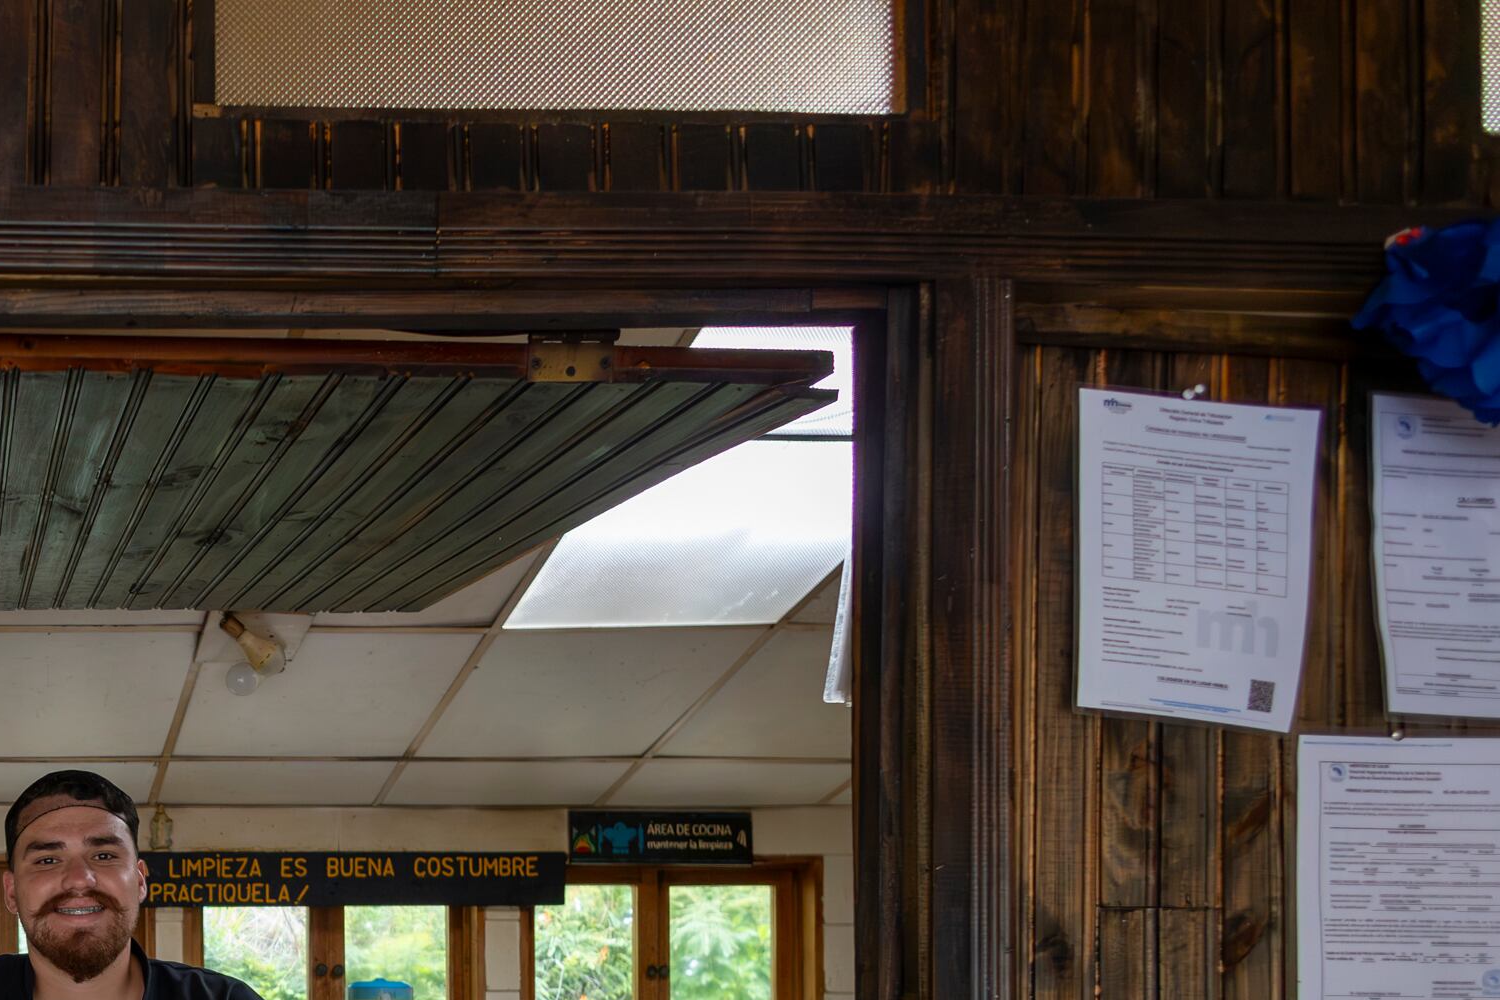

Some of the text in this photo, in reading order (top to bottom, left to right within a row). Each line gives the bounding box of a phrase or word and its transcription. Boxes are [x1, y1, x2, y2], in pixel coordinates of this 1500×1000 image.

[676, 824, 690, 836] DE
[691, 824, 733, 837] COCINA
[646, 840, 688, 850] mantener
[689, 839, 698, 850] la
[168, 854, 262, 879] LIMPIEZA
[280, 857, 309, 878] ES
[326, 857, 396, 879] BUENA
[413, 856, 540, 879] COSTUMBRE
